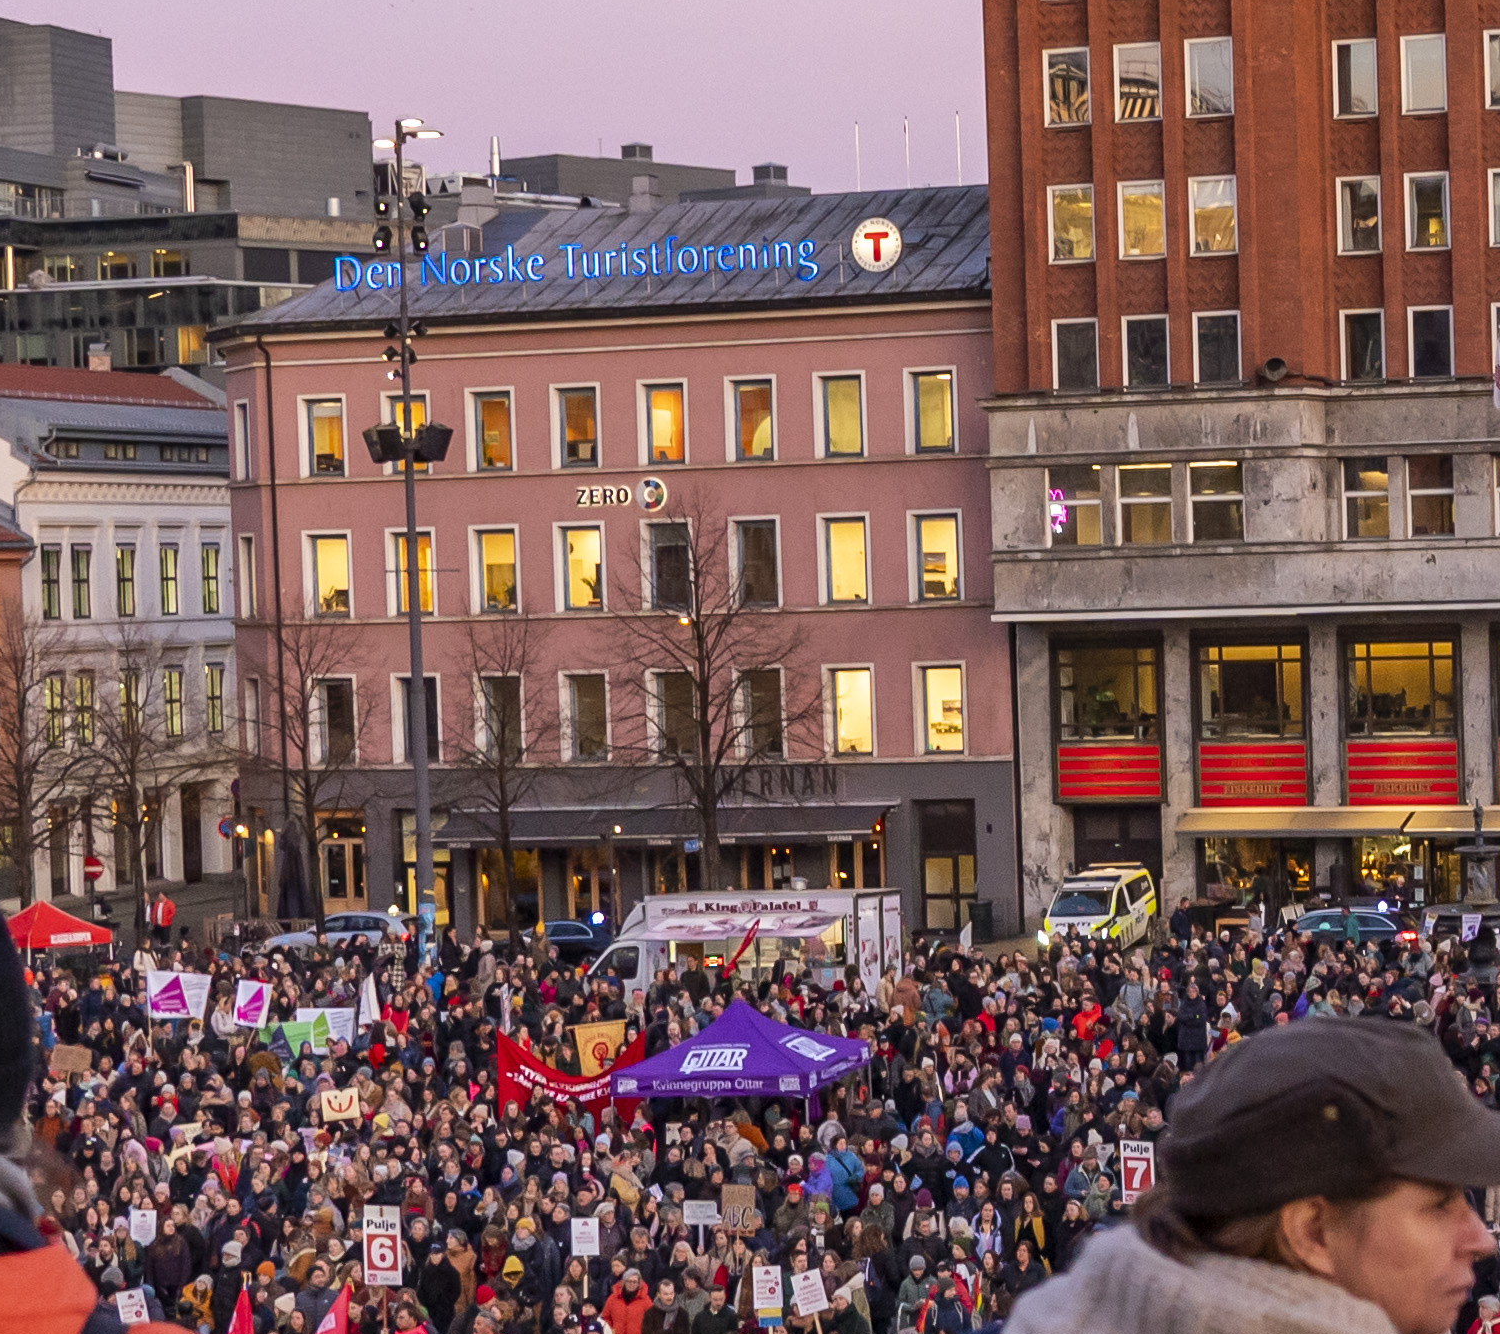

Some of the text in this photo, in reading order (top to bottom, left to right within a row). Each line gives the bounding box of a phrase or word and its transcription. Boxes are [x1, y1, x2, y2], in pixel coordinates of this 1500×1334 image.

[334, 235, 820, 292] Den Norske Turistforening
[576, 485, 632, 507] ZERO
[703, 900, 802, 914] King Falafel
[652, 1079, 732, 1093] Kvinnegruppa
[1123, 1142, 1150, 1156] Pulje
[1126, 1159, 1148, 1189] 7
[366, 1219, 397, 1232] Pulje
[370, 1236, 395, 1269] 6
